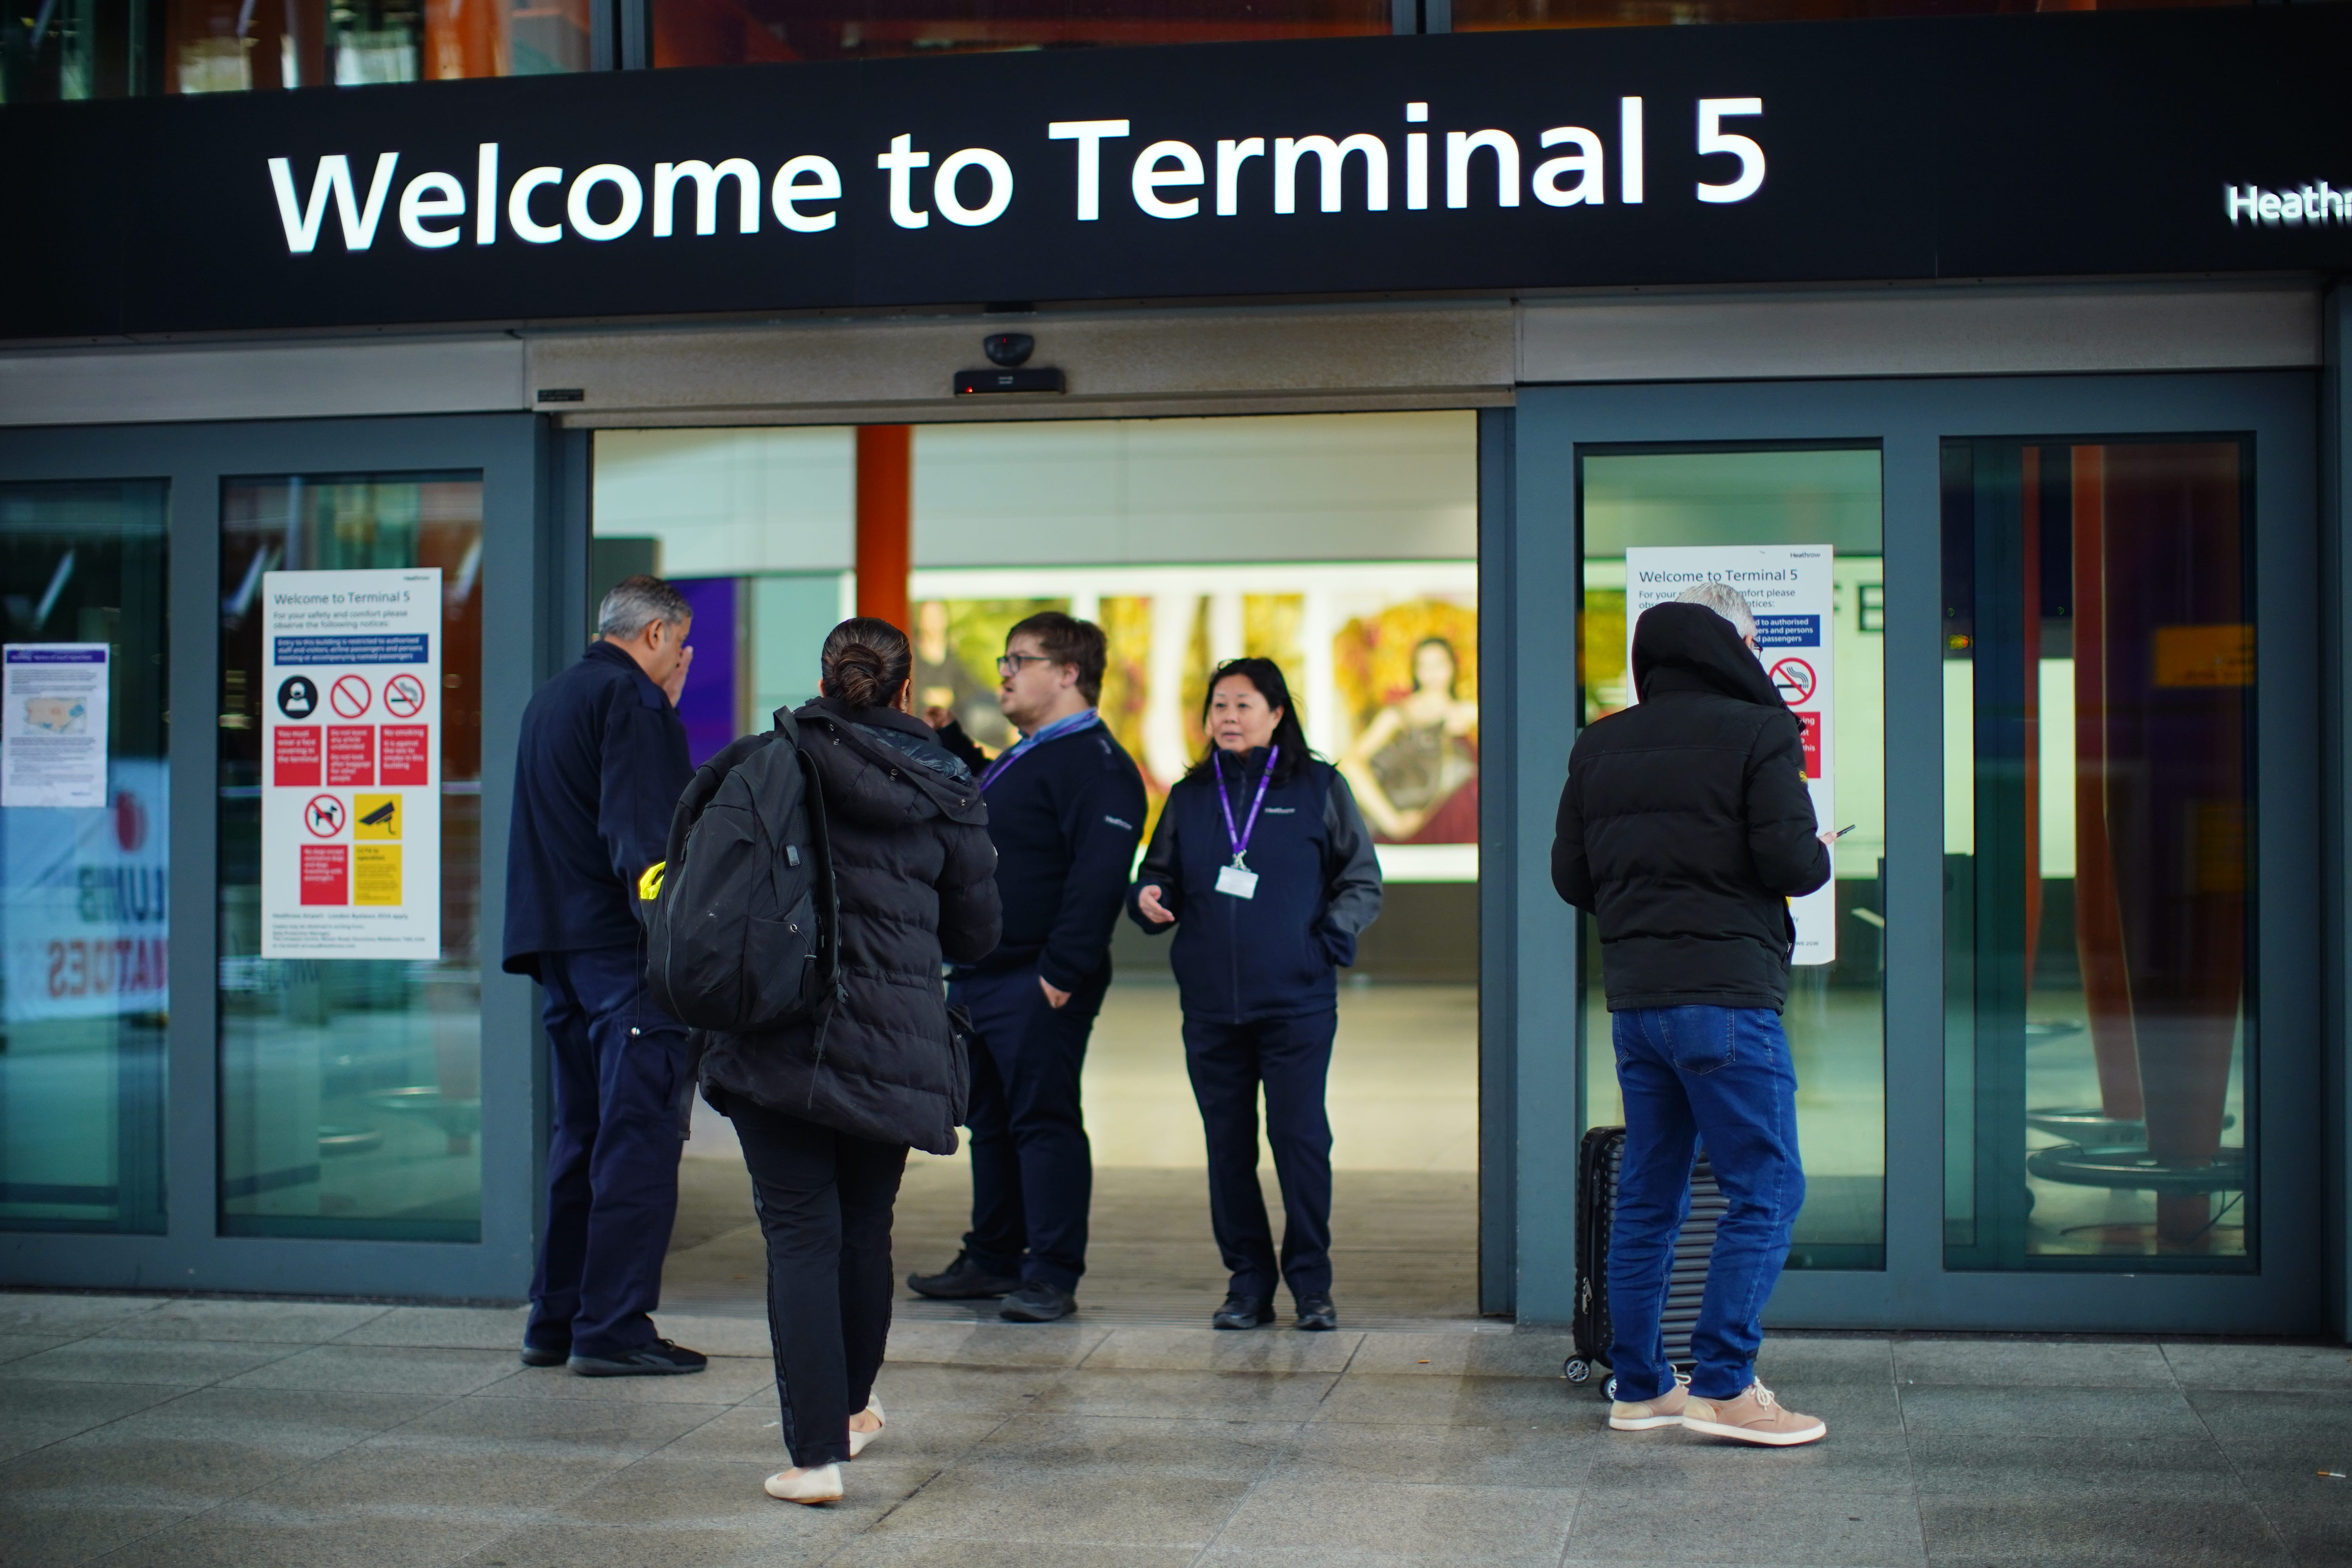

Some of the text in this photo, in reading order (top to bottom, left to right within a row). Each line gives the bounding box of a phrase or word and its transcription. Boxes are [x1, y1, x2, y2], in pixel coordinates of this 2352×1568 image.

[268, 96, 1765, 252] Welcome to Terminal 5
[1640, 569, 1798, 582] Welcome to Terminal 5
[274, 590, 410, 605] Welcome to Terminal 5
[1767, 589, 1796, 598] please
[307, 611, 331, 619] safety
[383, 610, 408, 618] please
[321, 620, 358, 629] following
[1785, 627, 1813, 636] persons
